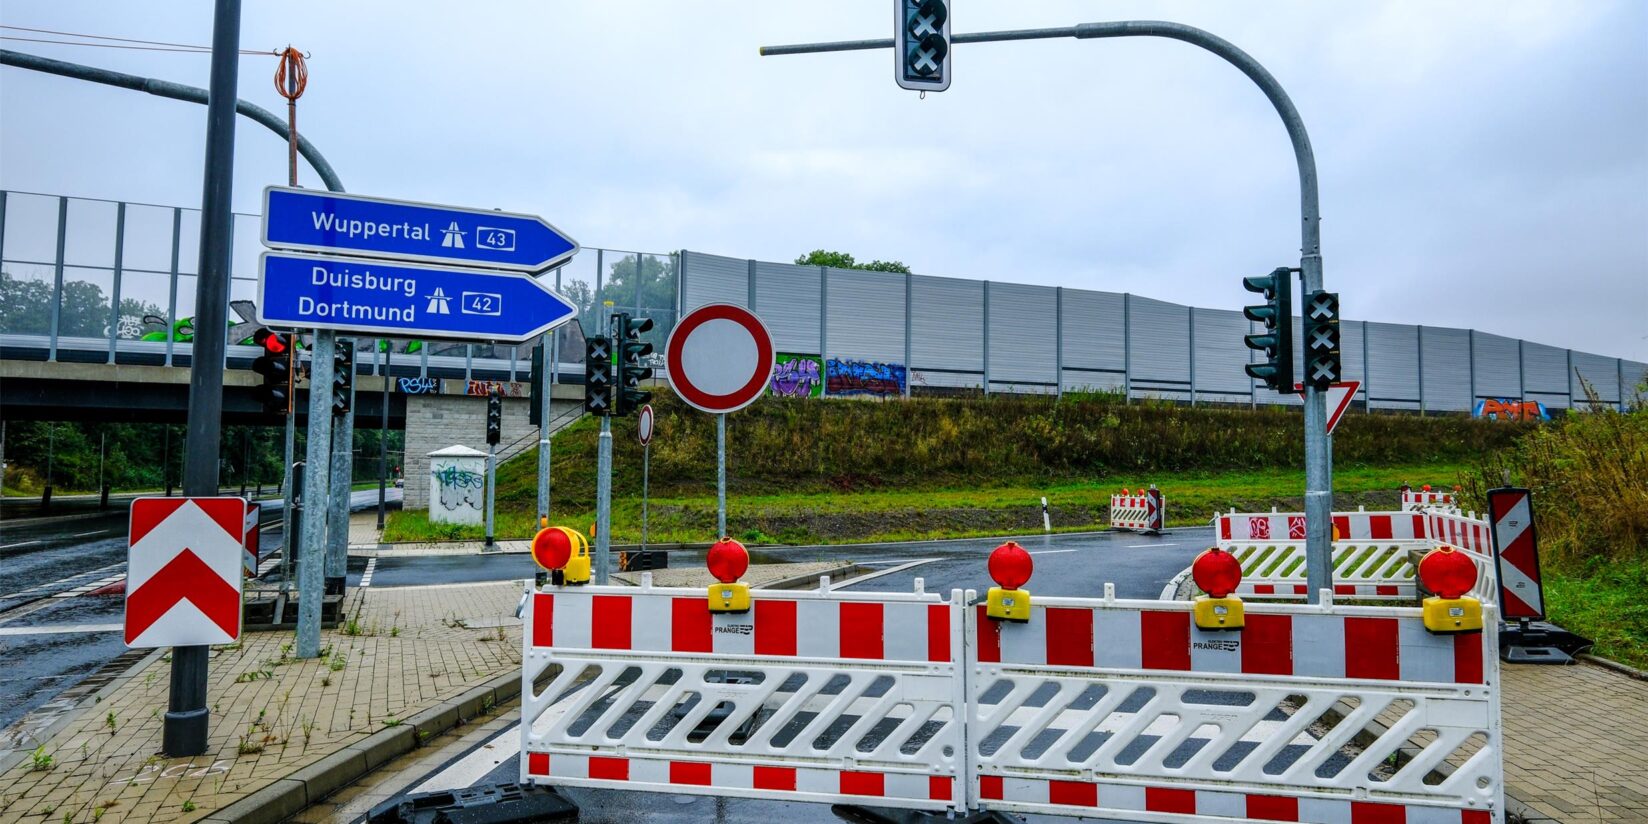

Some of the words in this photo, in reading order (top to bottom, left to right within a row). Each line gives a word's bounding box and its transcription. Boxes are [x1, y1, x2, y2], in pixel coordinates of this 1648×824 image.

[311, 210, 431, 242] Wuppertal
[486, 231, 507, 248] 43
[311, 266, 417, 298] Duisburg
[298, 296, 416, 323] Dortmund
[471, 296, 493, 312] 42
[714, 626, 740, 635] PRANGE
[1193, 642, 1223, 651] PRANGE
